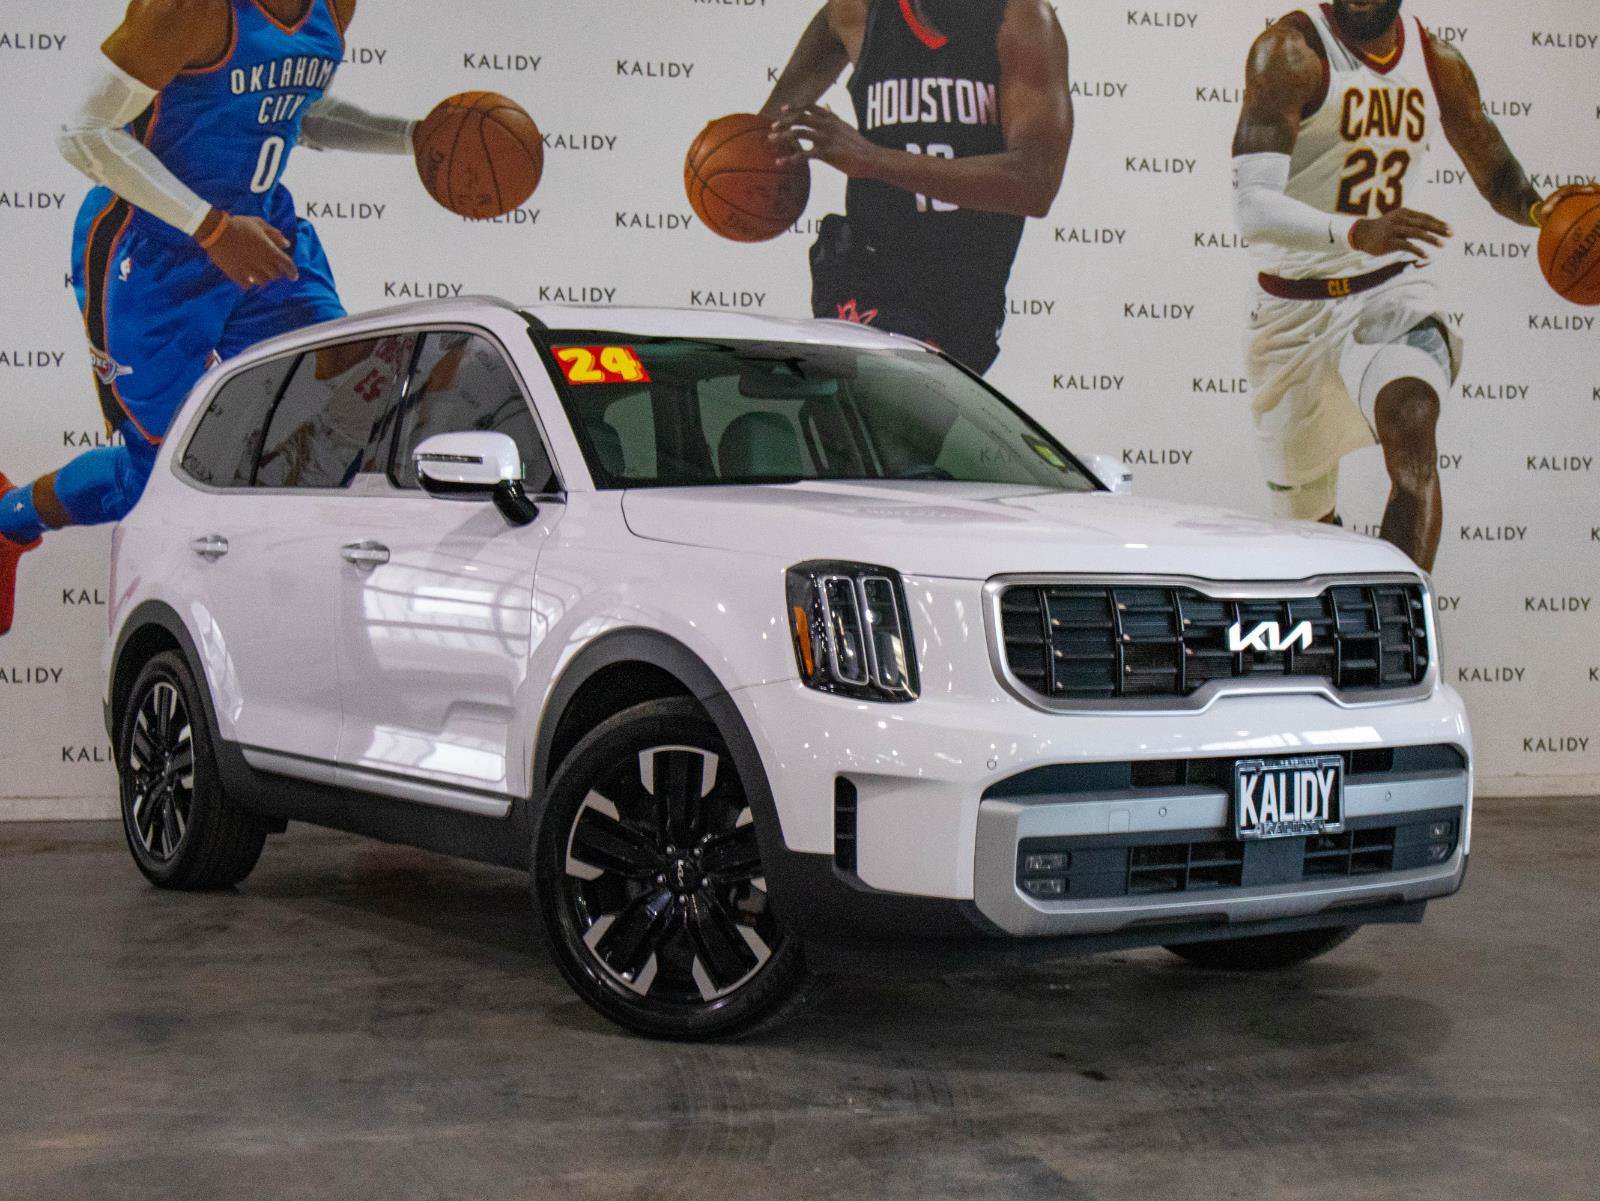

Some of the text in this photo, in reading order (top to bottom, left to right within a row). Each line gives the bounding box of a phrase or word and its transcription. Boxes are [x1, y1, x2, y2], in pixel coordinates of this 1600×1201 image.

[1127, 11, 1198, 28] KALIDY
[0, 33, 66, 50] ALIDY
[1432, 27, 1468, 43] IDY
[1532, 32, 1598, 48] KALIDY
[343, 48, 386, 65] IDY
[464, 53, 541, 71] KALIDY
[231, 57, 334, 95] OKLAHOM
[617, 60, 693, 78] KALIDY
[1070, 82, 1127, 98] ALIDY
[1196, 87, 1245, 103] KALI
[257, 94, 306, 124] CITY
[866, 77, 998, 130] HOUSTON
[1481, 101, 1532, 117] ALIDY
[1341, 87, 1425, 142] CAVS
[251, 136, 285, 193] 0
[1126, 157, 1196, 173] KALIDY
[1336, 148, 1410, 216] 23
[1427, 169, 1466, 184] IDY
[0, 192, 65, 209] ALIDY
[306, 202, 386, 219] KALIDY
[616, 212, 692, 229] KALIDY
[1055, 228, 1126, 243] KALIDY
[1464, 242, 1530, 258] KALIDY
[384, 282, 463, 299] KALIDY
[539, 286, 616, 303] KALIDY
[691, 291, 765, 307] KALIDY
[1004, 300, 1055, 316] LIDY
[1124, 303, 1194, 319] KALIDY
[1529, 315, 1594, 330] KALIDY
[0, 351, 64, 367] ALIDY
[558, 347, 643, 382] 24
[1053, 375, 1124, 390] KALIDY
[1192, 378, 1247, 393] KALID
[1462, 385, 1528, 399] KALIDY
[1123, 449, 1192, 464] KALIDY
[1527, 457, 1592, 471] KALIDY
[1461, 526, 1527, 541] KALIDY
[62, 588, 105, 605] KAL
[1525, 597, 1591, 611] KALIDY
[0, 667, 63, 683] ALIDY
[1458, 667, 1525, 682] KALIDY
[1523, 737, 1589, 752] KALIDY
[62, 746, 112, 763] KALI
[1240, 769, 1336, 827] KALIDY
